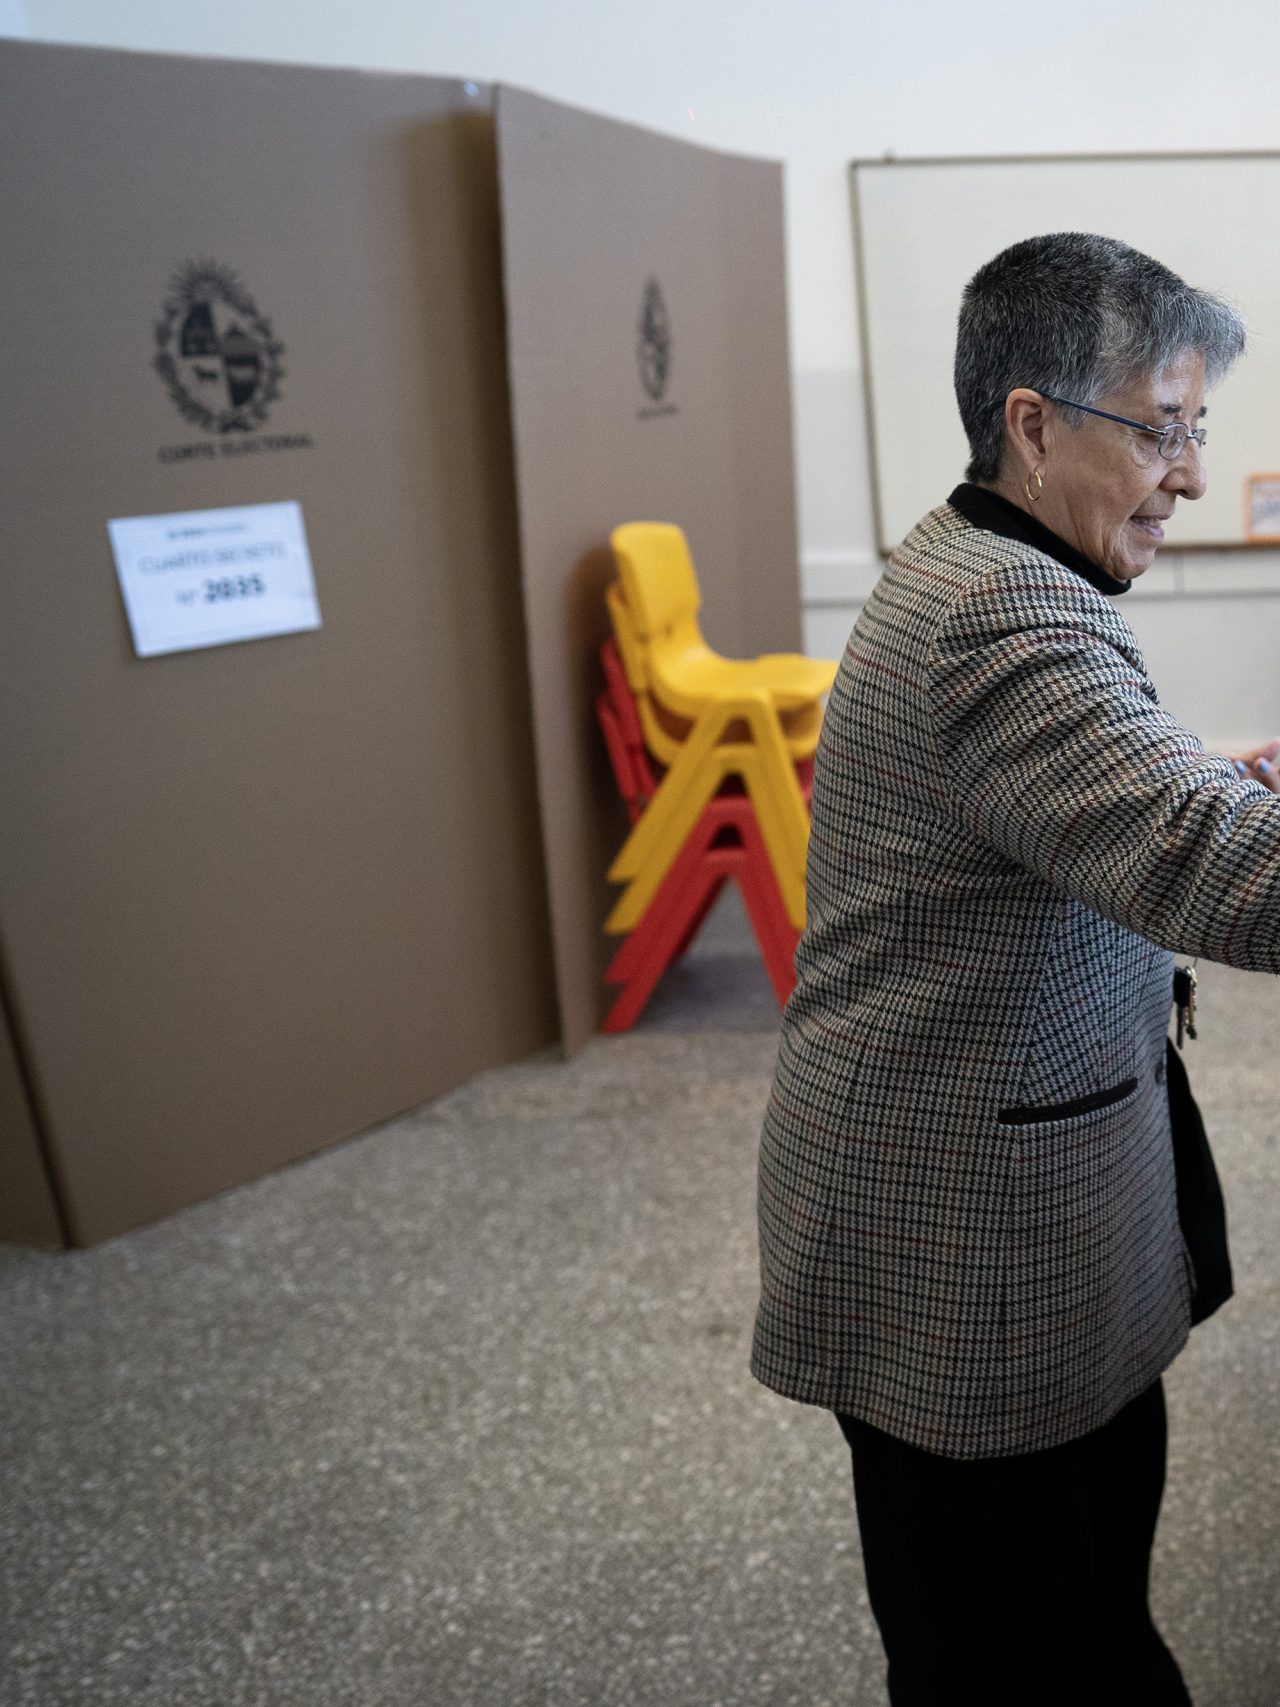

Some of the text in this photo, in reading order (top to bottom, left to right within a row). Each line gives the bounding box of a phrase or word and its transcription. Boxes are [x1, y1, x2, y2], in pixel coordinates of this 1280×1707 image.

[158, 434, 314, 463] CORTE ELECTORAL
[203, 572, 267, 604] 2035
